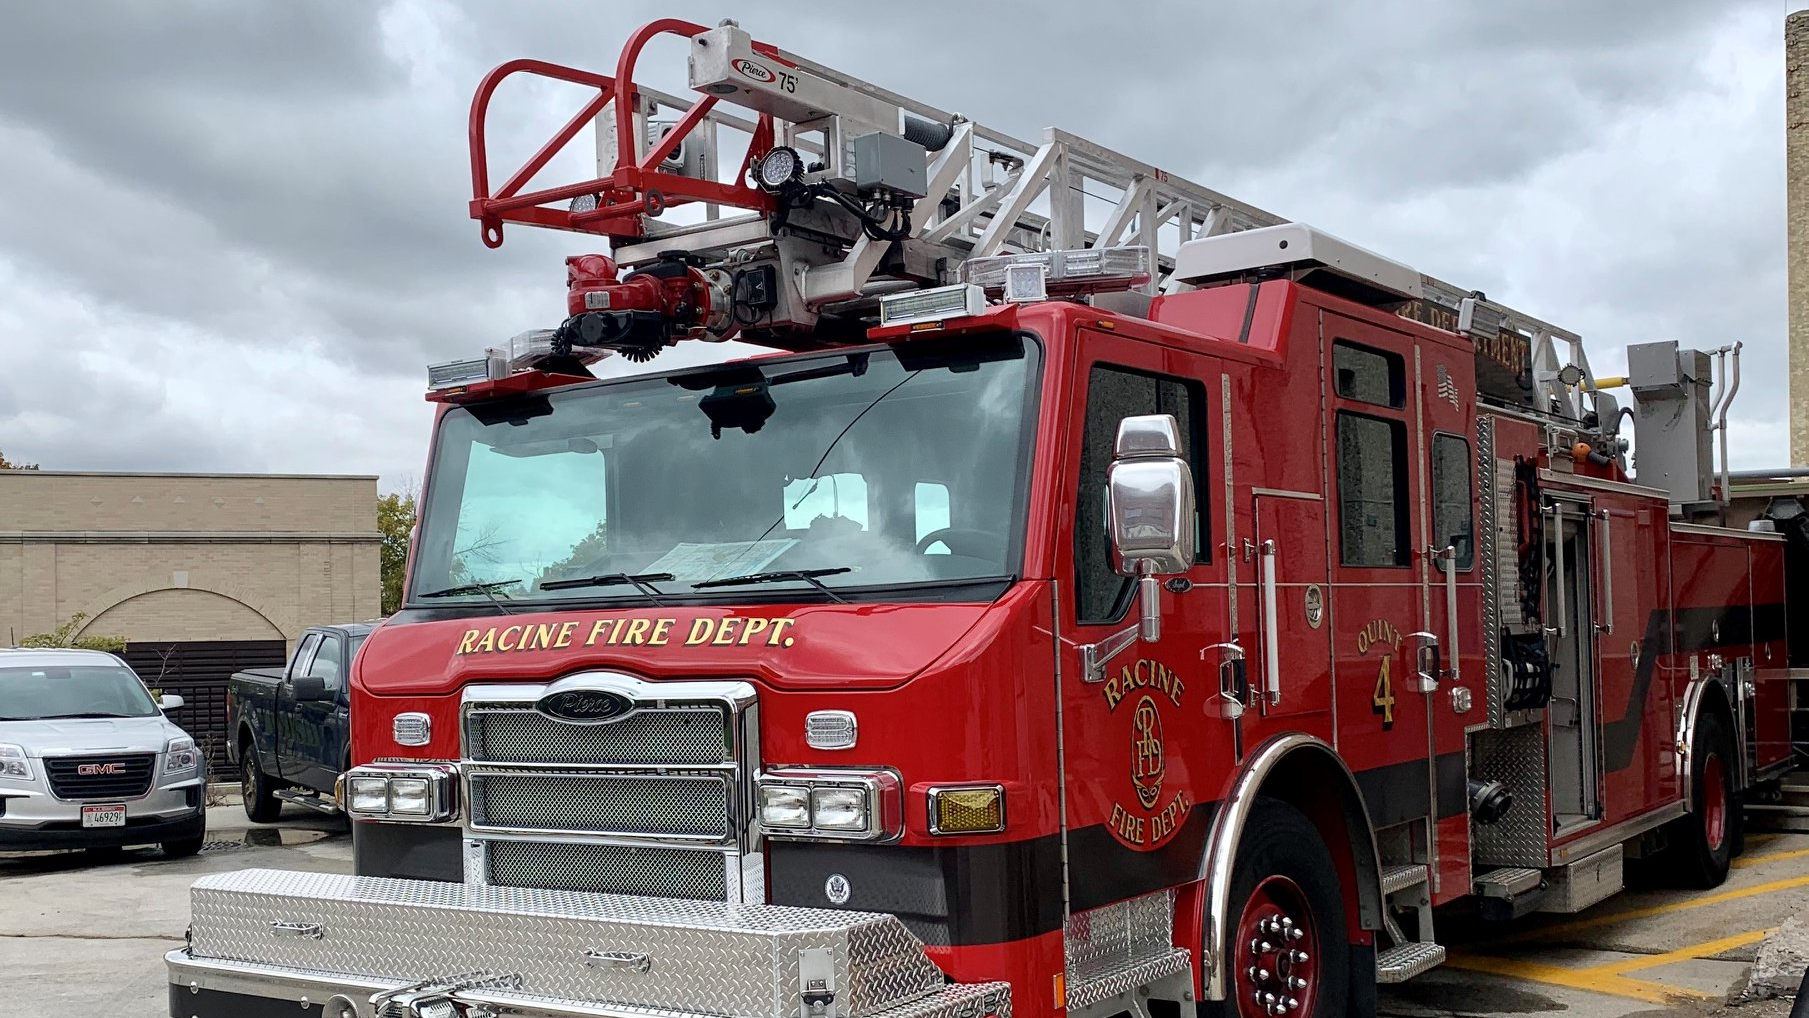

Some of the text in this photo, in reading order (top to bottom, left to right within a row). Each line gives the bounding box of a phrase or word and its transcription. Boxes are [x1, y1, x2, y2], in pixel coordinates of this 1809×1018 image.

[741, 61, 766, 78] Pierce
[456, 617, 796, 655] RACINE FIRE DEPT.
[1358, 620, 1402, 654] QUINT
[1103, 658, 1186, 711] RACINE
[1373, 655, 1395, 723] 4
[560, 693, 613, 716] Pierce
[78, 763, 126, 775] GMC
[1109, 790, 1190, 844] FIRE DEPT.
